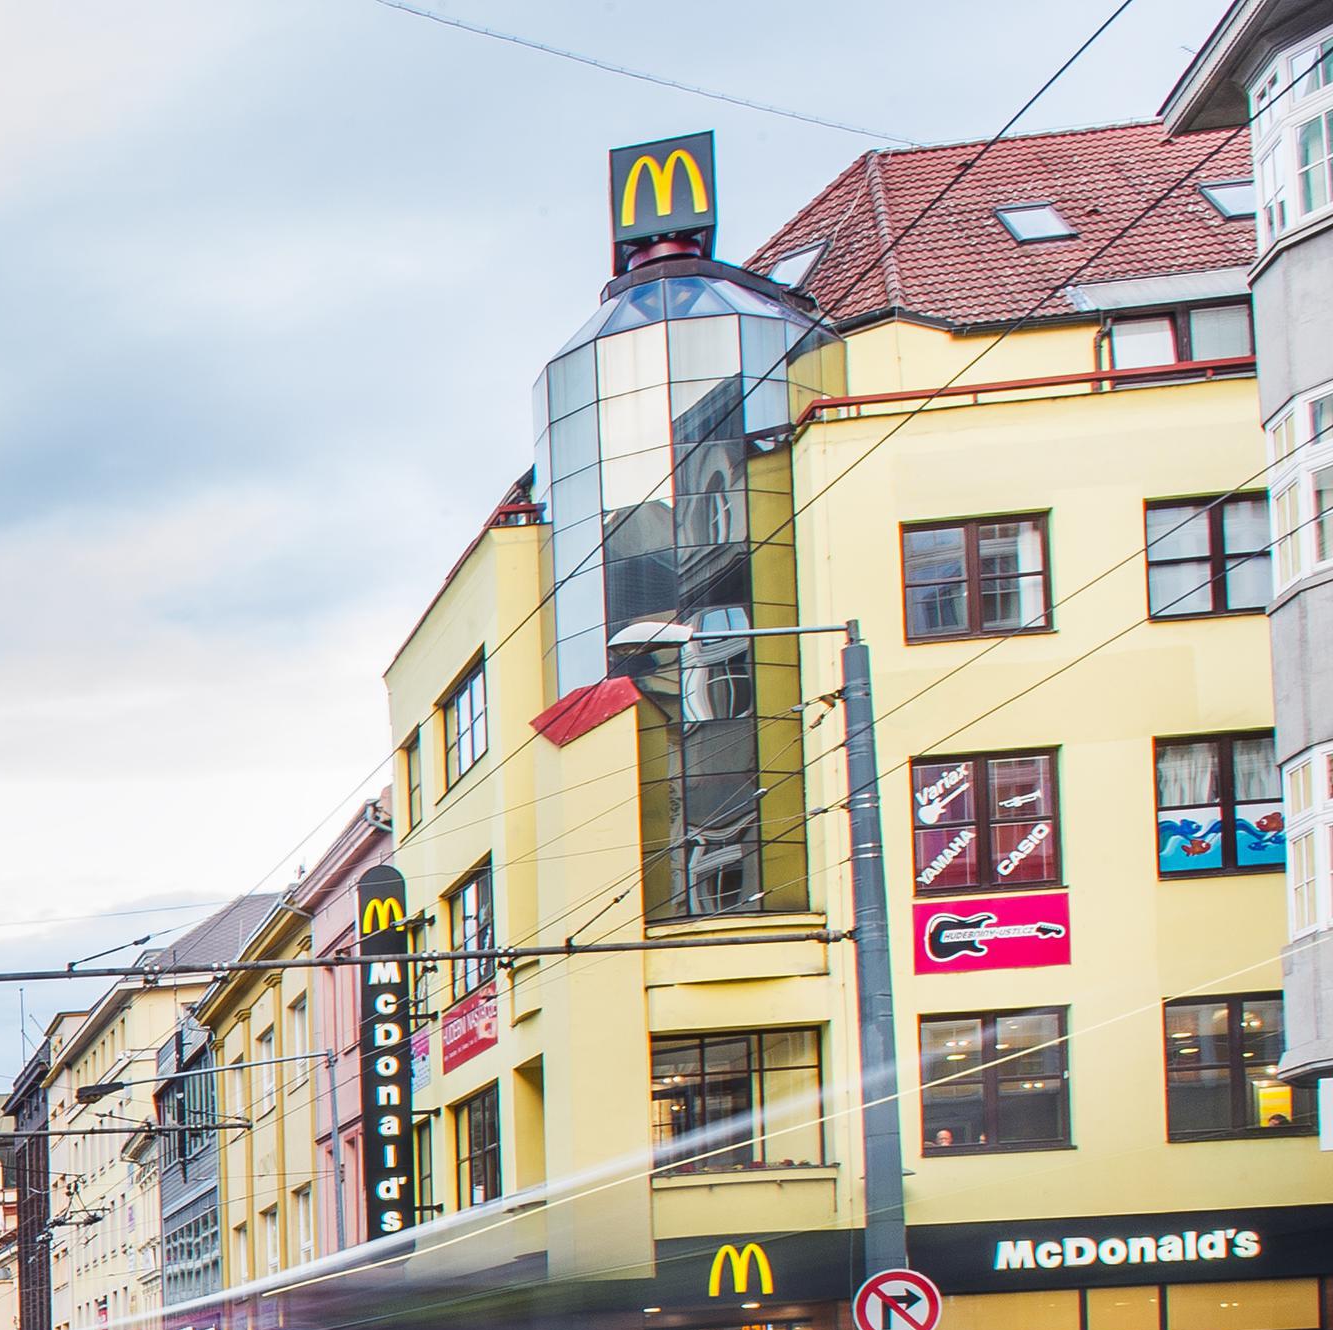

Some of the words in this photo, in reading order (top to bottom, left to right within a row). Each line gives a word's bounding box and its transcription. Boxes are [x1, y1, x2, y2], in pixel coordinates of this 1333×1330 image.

[915, 763, 969, 805] Variax
[916, 830, 976, 885] YAMAHA
[997, 823, 1051, 876] CASIO
[994, 1227, 1262, 1271] McDonald's
